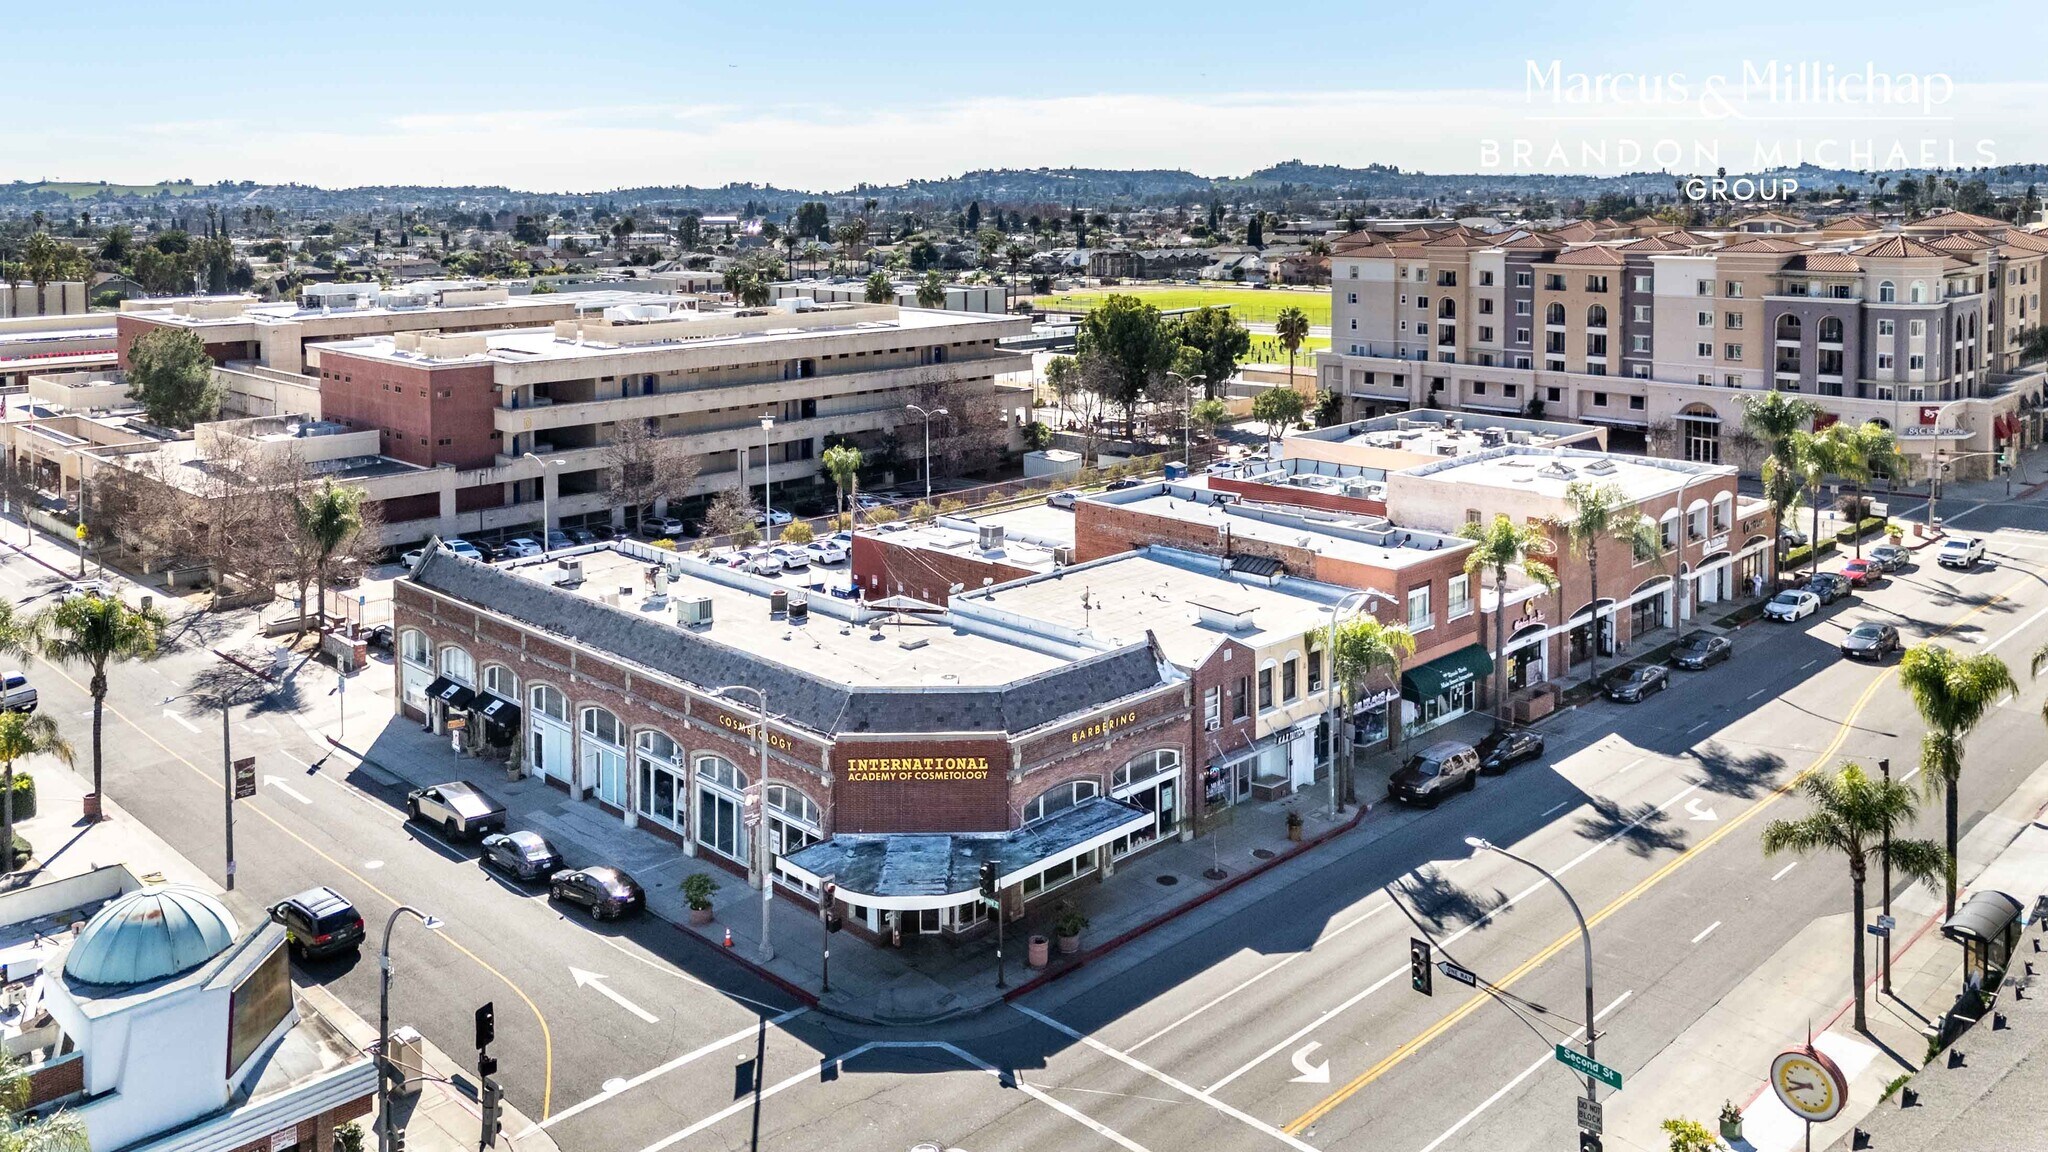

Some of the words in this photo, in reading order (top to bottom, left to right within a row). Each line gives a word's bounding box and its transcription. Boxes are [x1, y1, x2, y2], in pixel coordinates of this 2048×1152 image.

[719, 714, 792, 751] COSMETOLOGY
[1071, 712, 1136, 743] BARBERING
[847, 757, 989, 771] INTERNATIONAL
[847, 772, 896, 781] ACADEMY
[899, 771, 913, 780] OF
[914, 771, 988, 780] COSMETOLOGY
[1563, 1048, 1599, 1073] Second
[1602, 1067, 1614, 1080] St
[1579, 1101, 1588, 1110] DO
[1589, 1103, 1601, 1115] NOT
[1579, 1110, 1601, 1124] BLOCK
